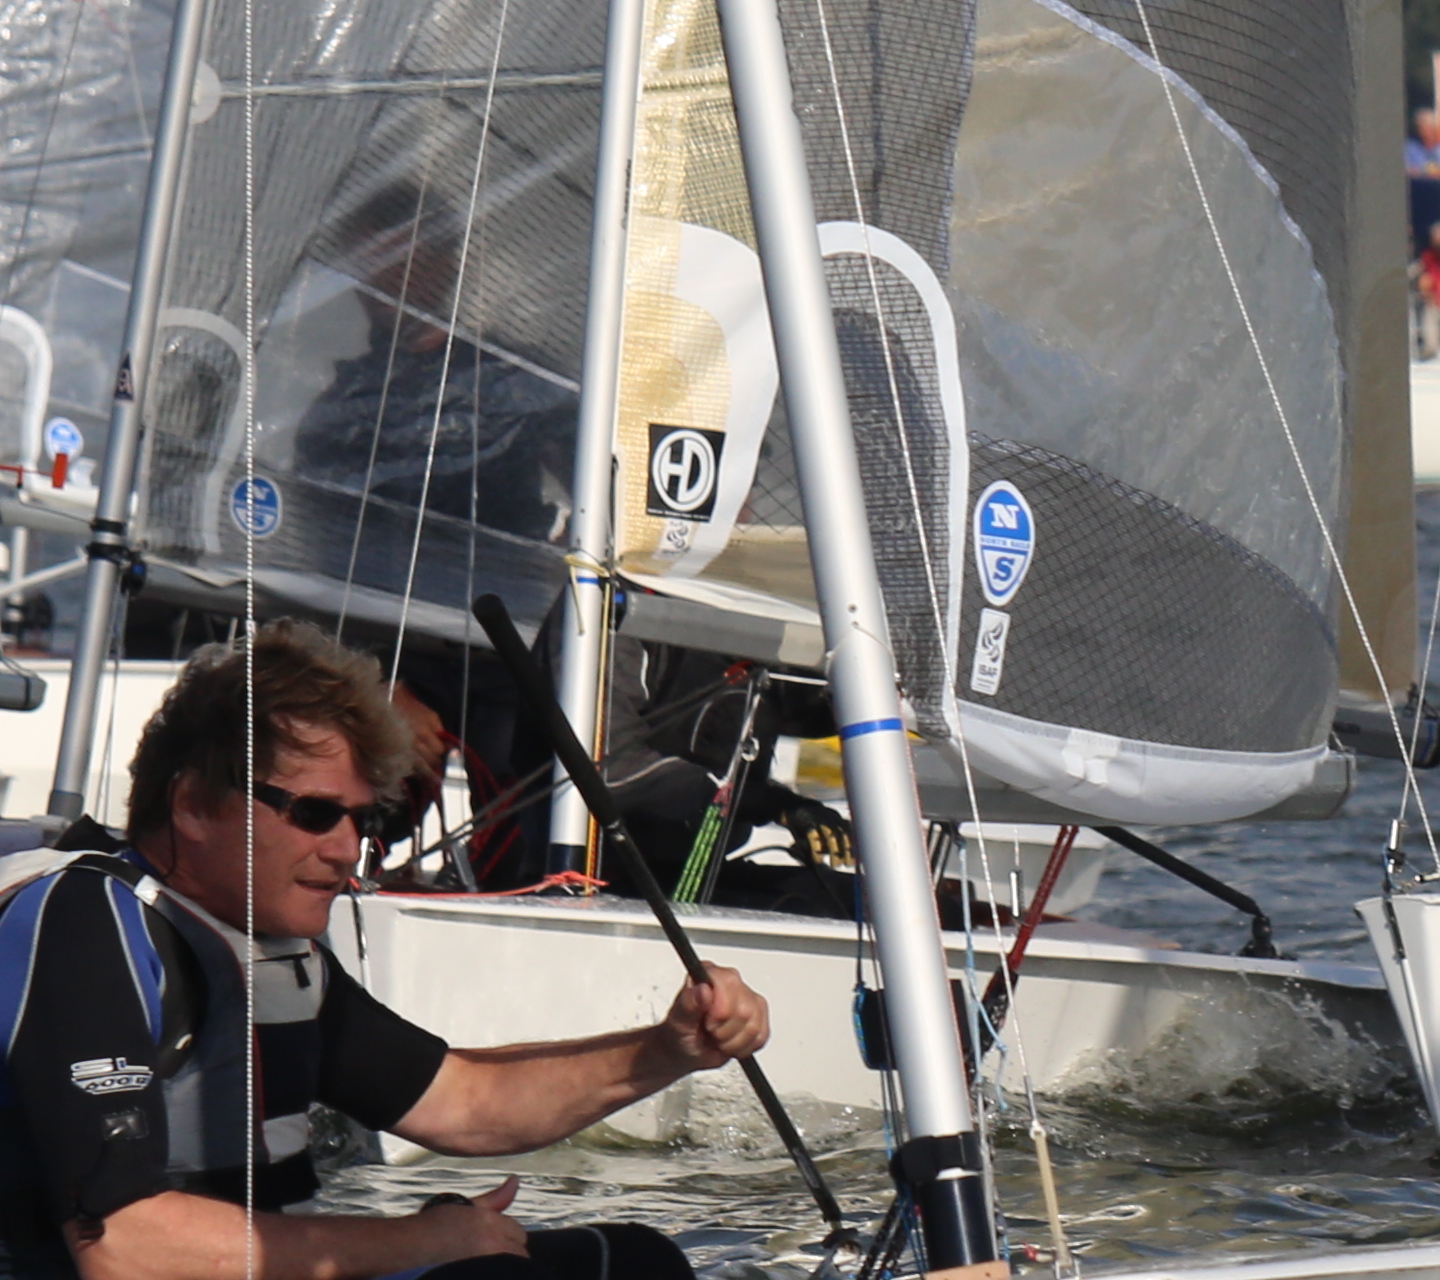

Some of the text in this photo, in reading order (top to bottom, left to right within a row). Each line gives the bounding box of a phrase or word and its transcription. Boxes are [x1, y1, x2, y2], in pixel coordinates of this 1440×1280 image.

[659, 437, 711, 504] HD
[988, 502, 1020, 530] N
[992, 555, 1015, 582] S
